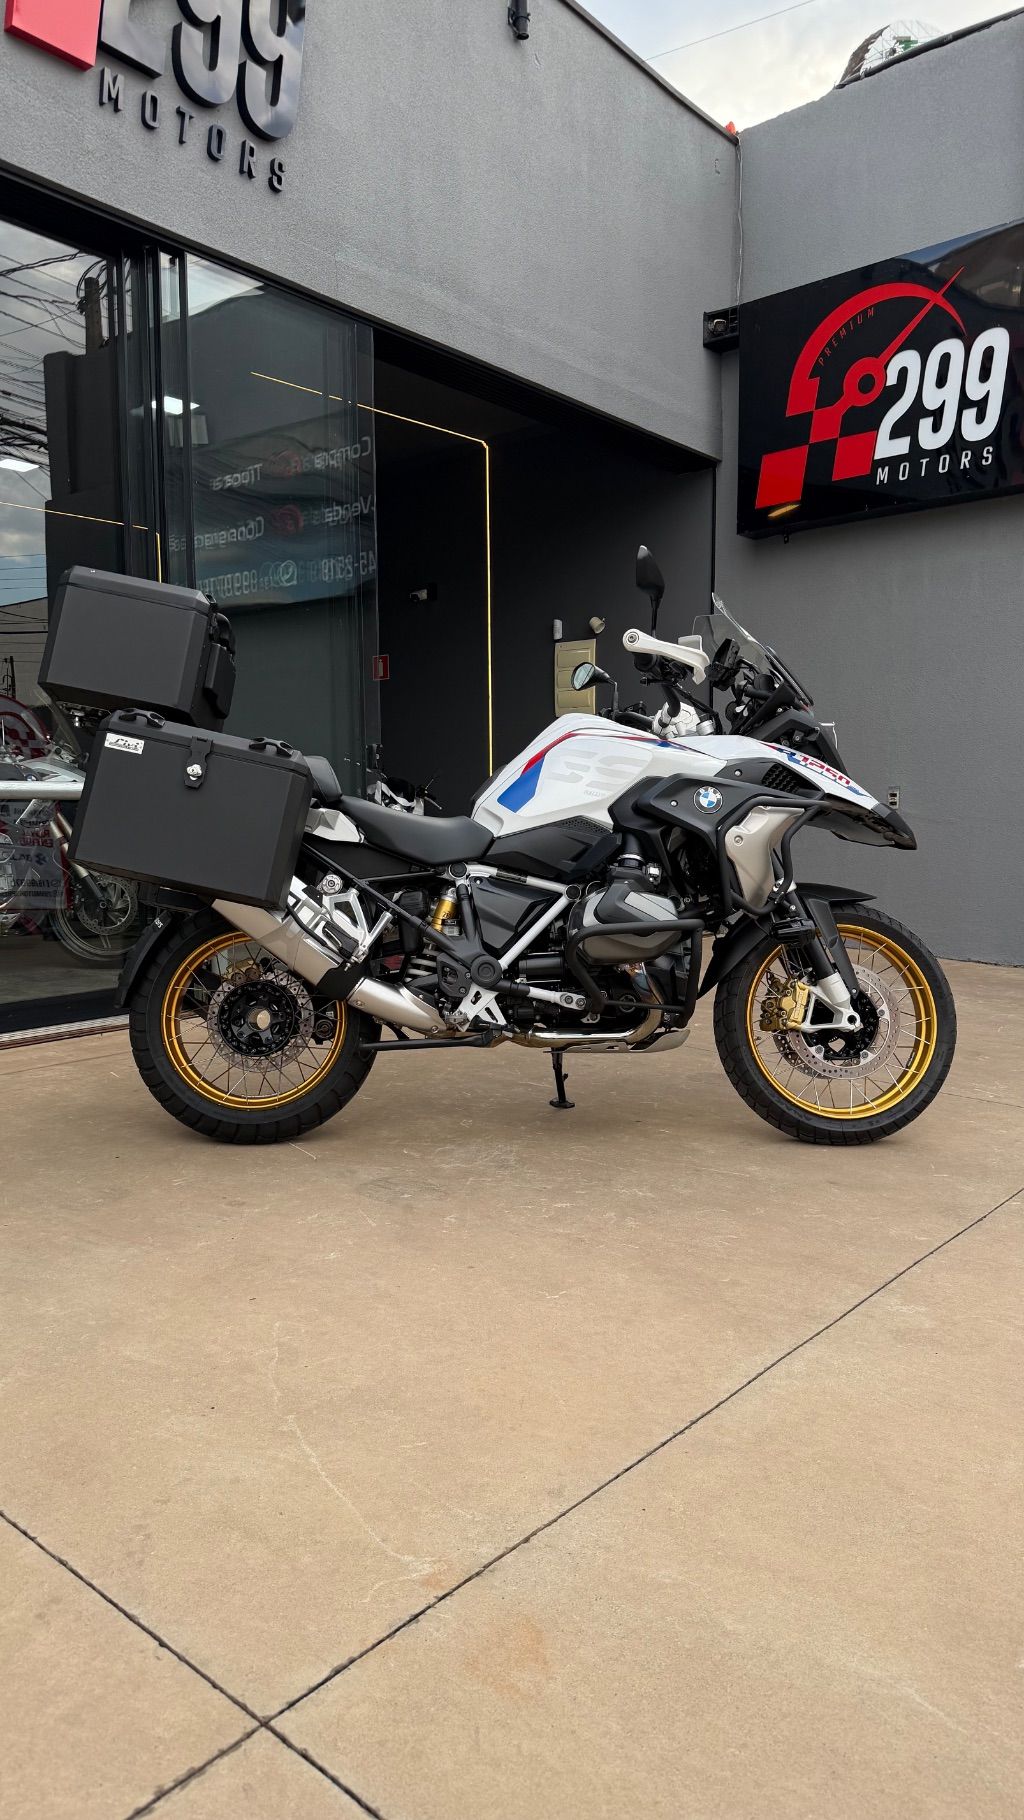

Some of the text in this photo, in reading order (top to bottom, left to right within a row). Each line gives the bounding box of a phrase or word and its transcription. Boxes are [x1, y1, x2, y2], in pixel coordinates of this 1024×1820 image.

[100, 66, 287, 193] MOTORS
[818, 307, 875, 367] PREMIUM
[875, 327, 1009, 460] 299
[876, 446, 994, 485] MOTORS
